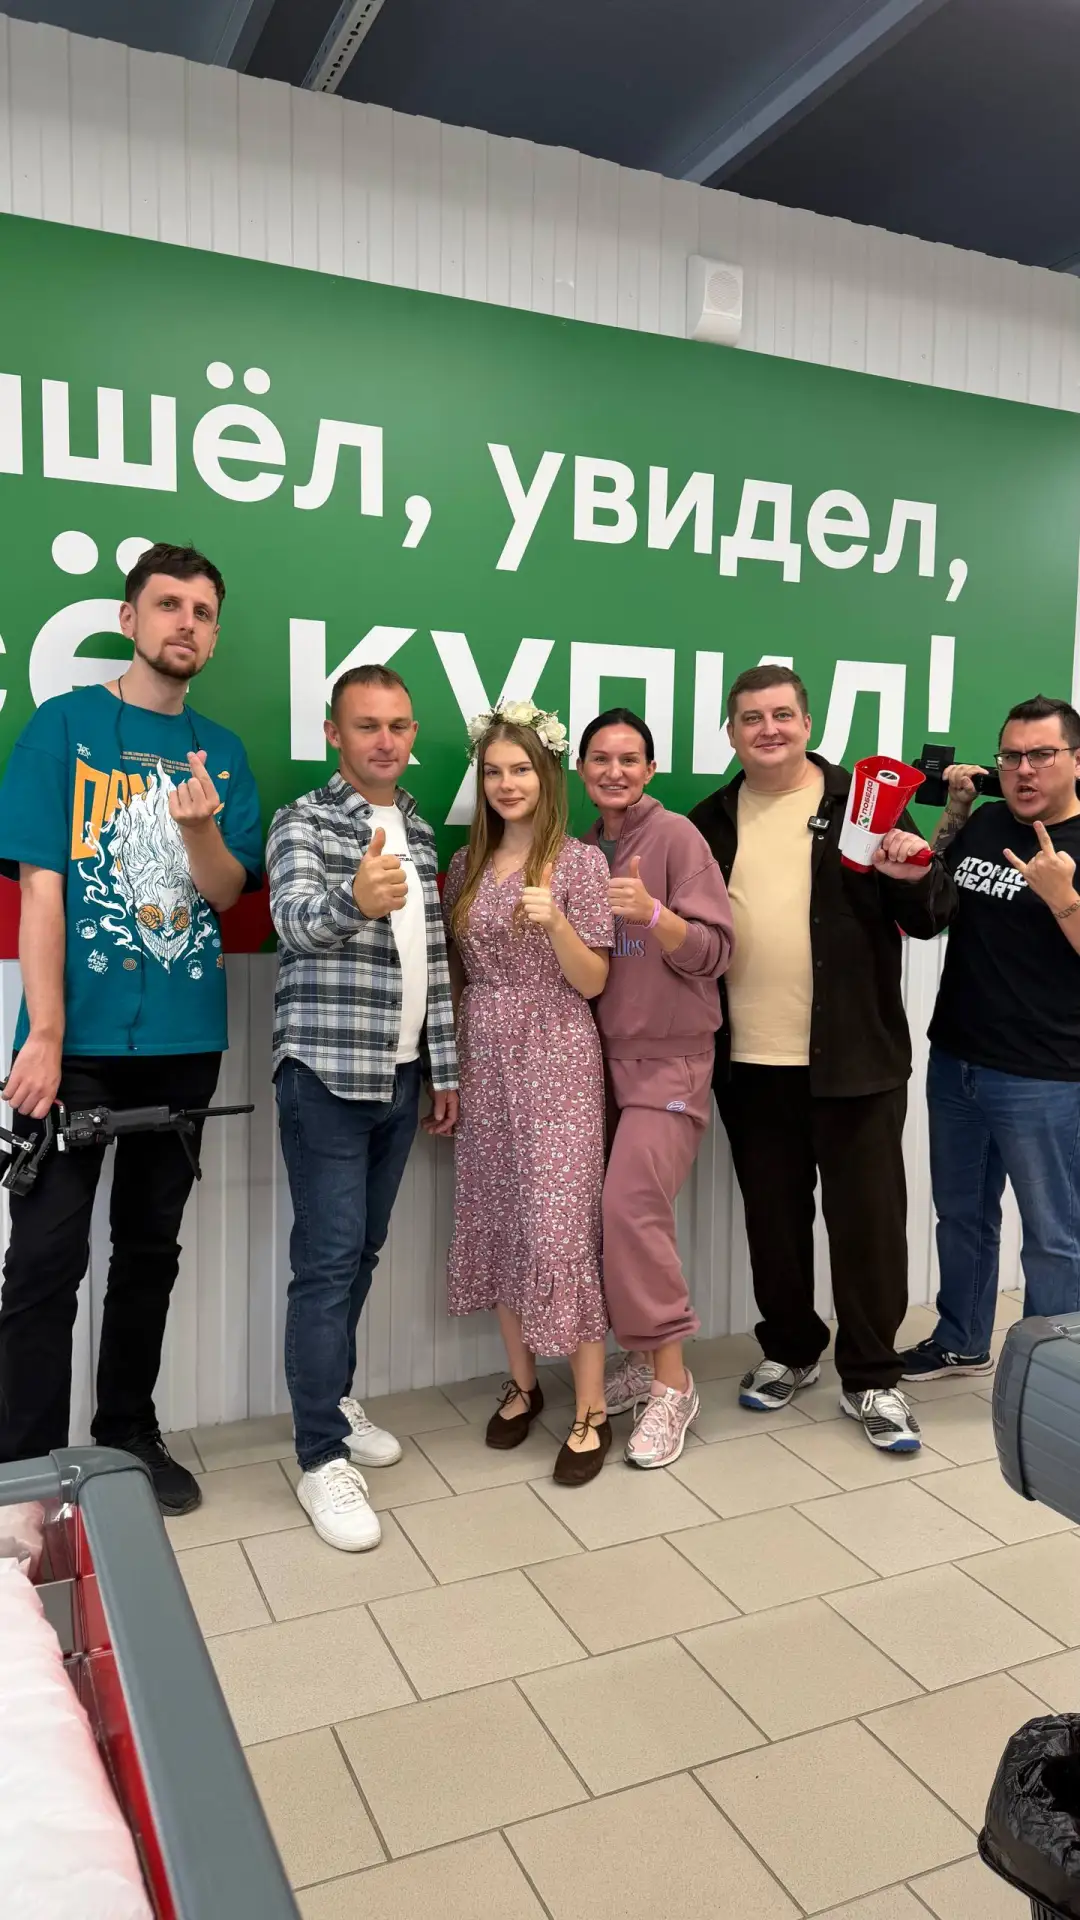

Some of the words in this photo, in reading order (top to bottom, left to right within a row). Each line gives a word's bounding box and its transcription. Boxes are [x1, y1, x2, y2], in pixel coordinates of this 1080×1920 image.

[487, 443, 968, 602] увидел,
[954, 869, 1021, 901] HEART
[957, 856, 1028, 887] ATOMIC
